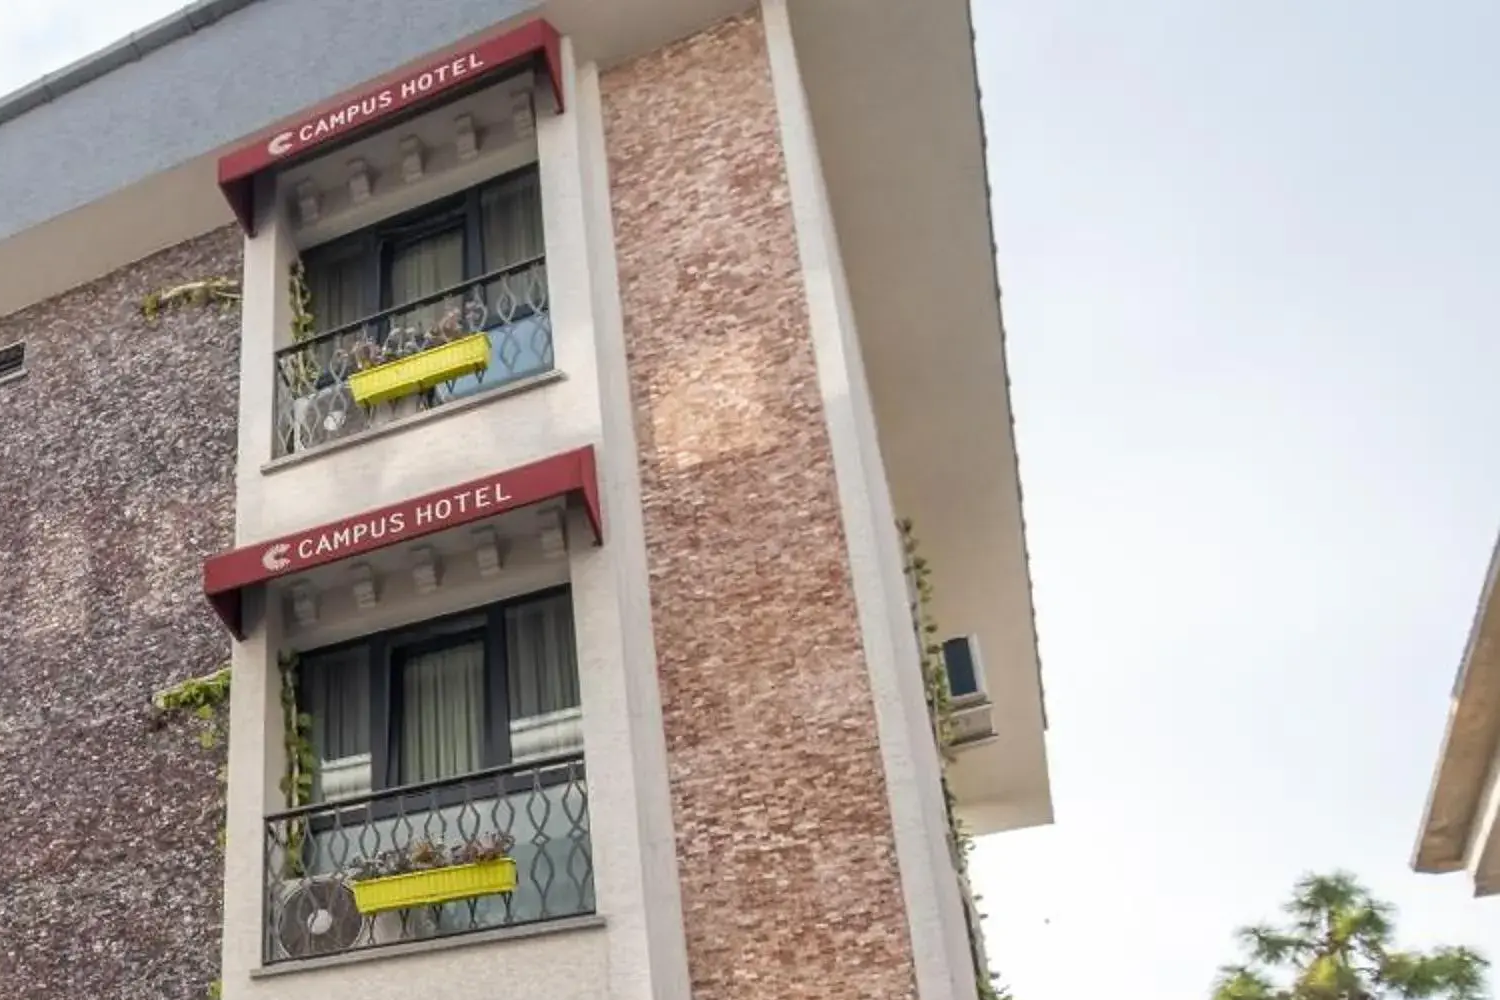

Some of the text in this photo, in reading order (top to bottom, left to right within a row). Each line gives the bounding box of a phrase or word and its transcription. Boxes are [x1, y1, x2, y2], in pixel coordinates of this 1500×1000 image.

[299, 90, 392, 142] CAMPUS
[401, 52, 484, 98] HOTEL
[298, 512, 405, 559] CAMPUS
[415, 483, 513, 526] HOTEL
